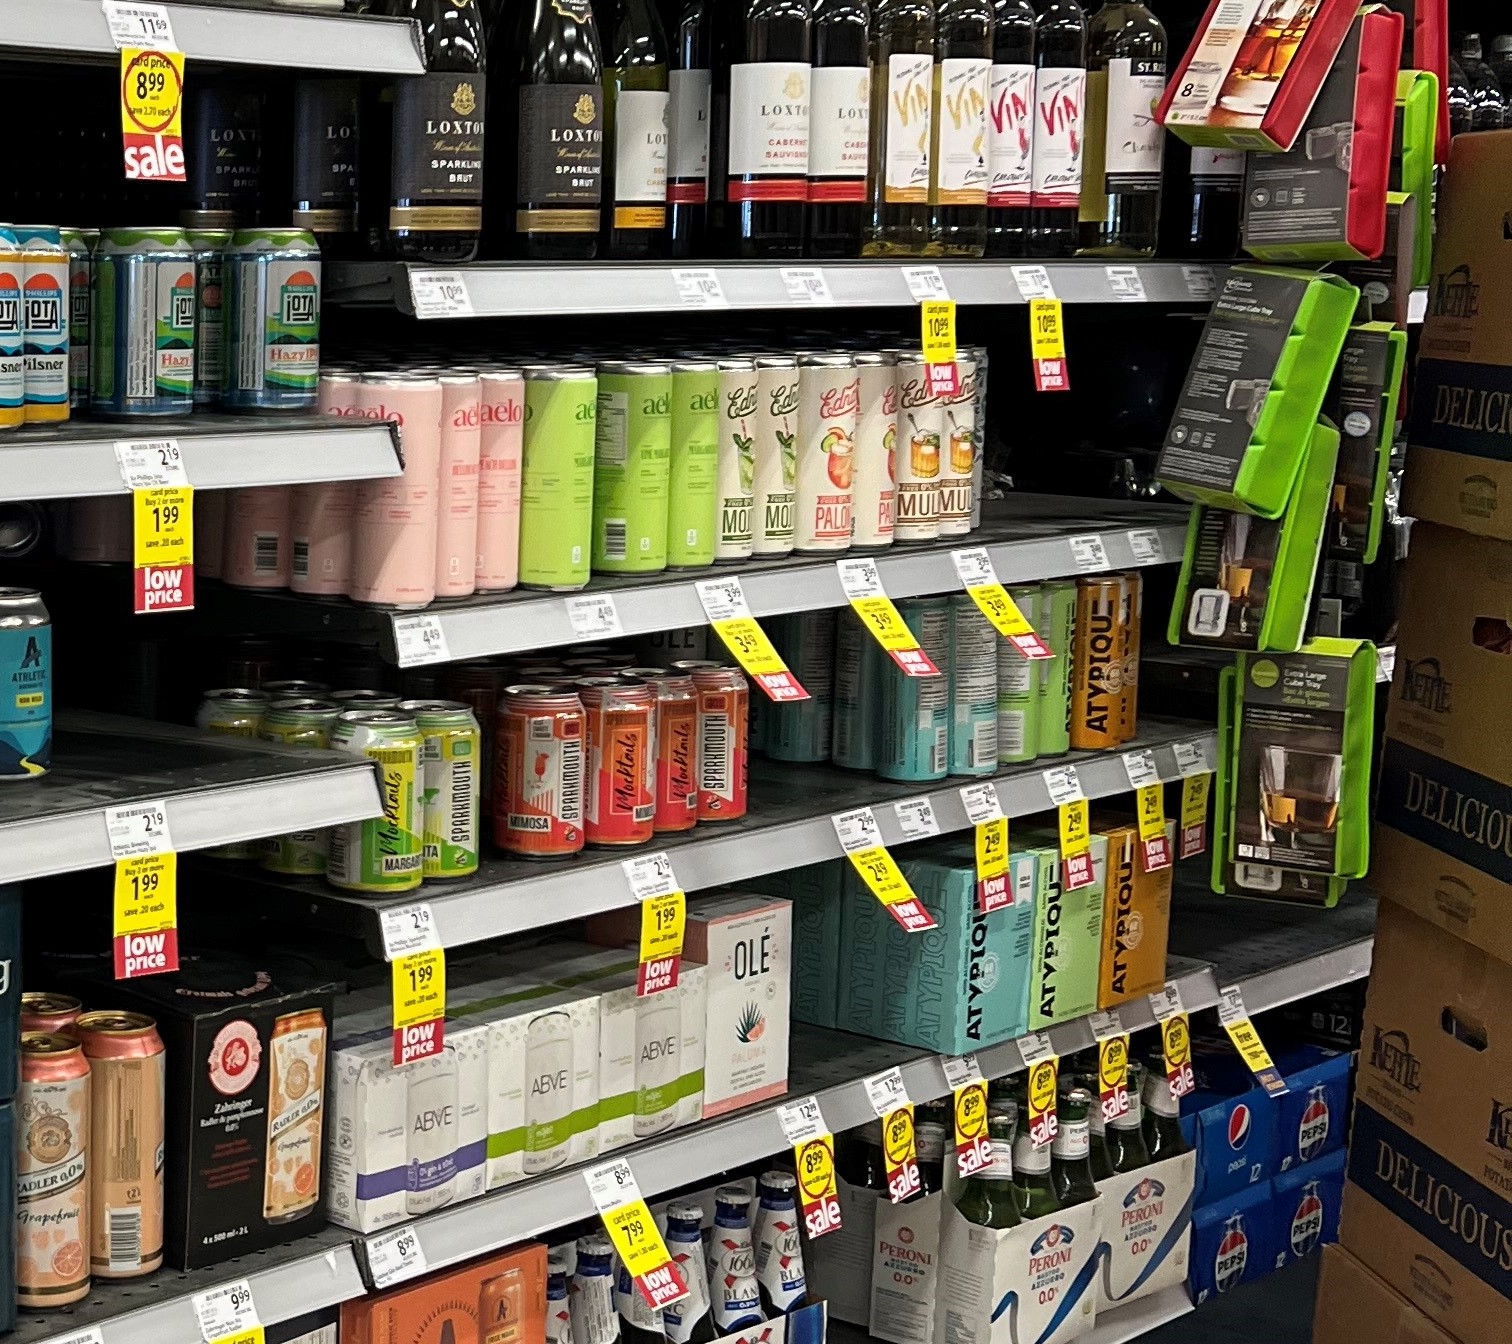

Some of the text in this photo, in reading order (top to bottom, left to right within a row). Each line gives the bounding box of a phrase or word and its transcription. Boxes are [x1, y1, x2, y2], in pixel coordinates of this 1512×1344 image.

[124, 144, 185, 180] sale
[448, 173, 474, 183] BRUT
[144, 567, 183, 591] low
[561, 739, 580, 822] SPARKMOUTH
[616, 731, 639, 813] Mocktails
[379, 769, 403, 858] Mocktails
[450, 760, 472, 845] SPARKMOUTH
[509, 813, 551, 832] MIMOSA
[123, 933, 166, 975] low price
[733, 925, 773, 982] OLÉ
[1298, 1119, 1330, 1147] PEPSI
[16, 1207, 81, 1226] Grapefruit
[1120, 1200, 1164, 1228] PERONI
[880, 1239, 933, 1266] PERONI
[1028, 1246, 1073, 1276] PERONI
[1215, 1248, 1248, 1274] PEPSI
